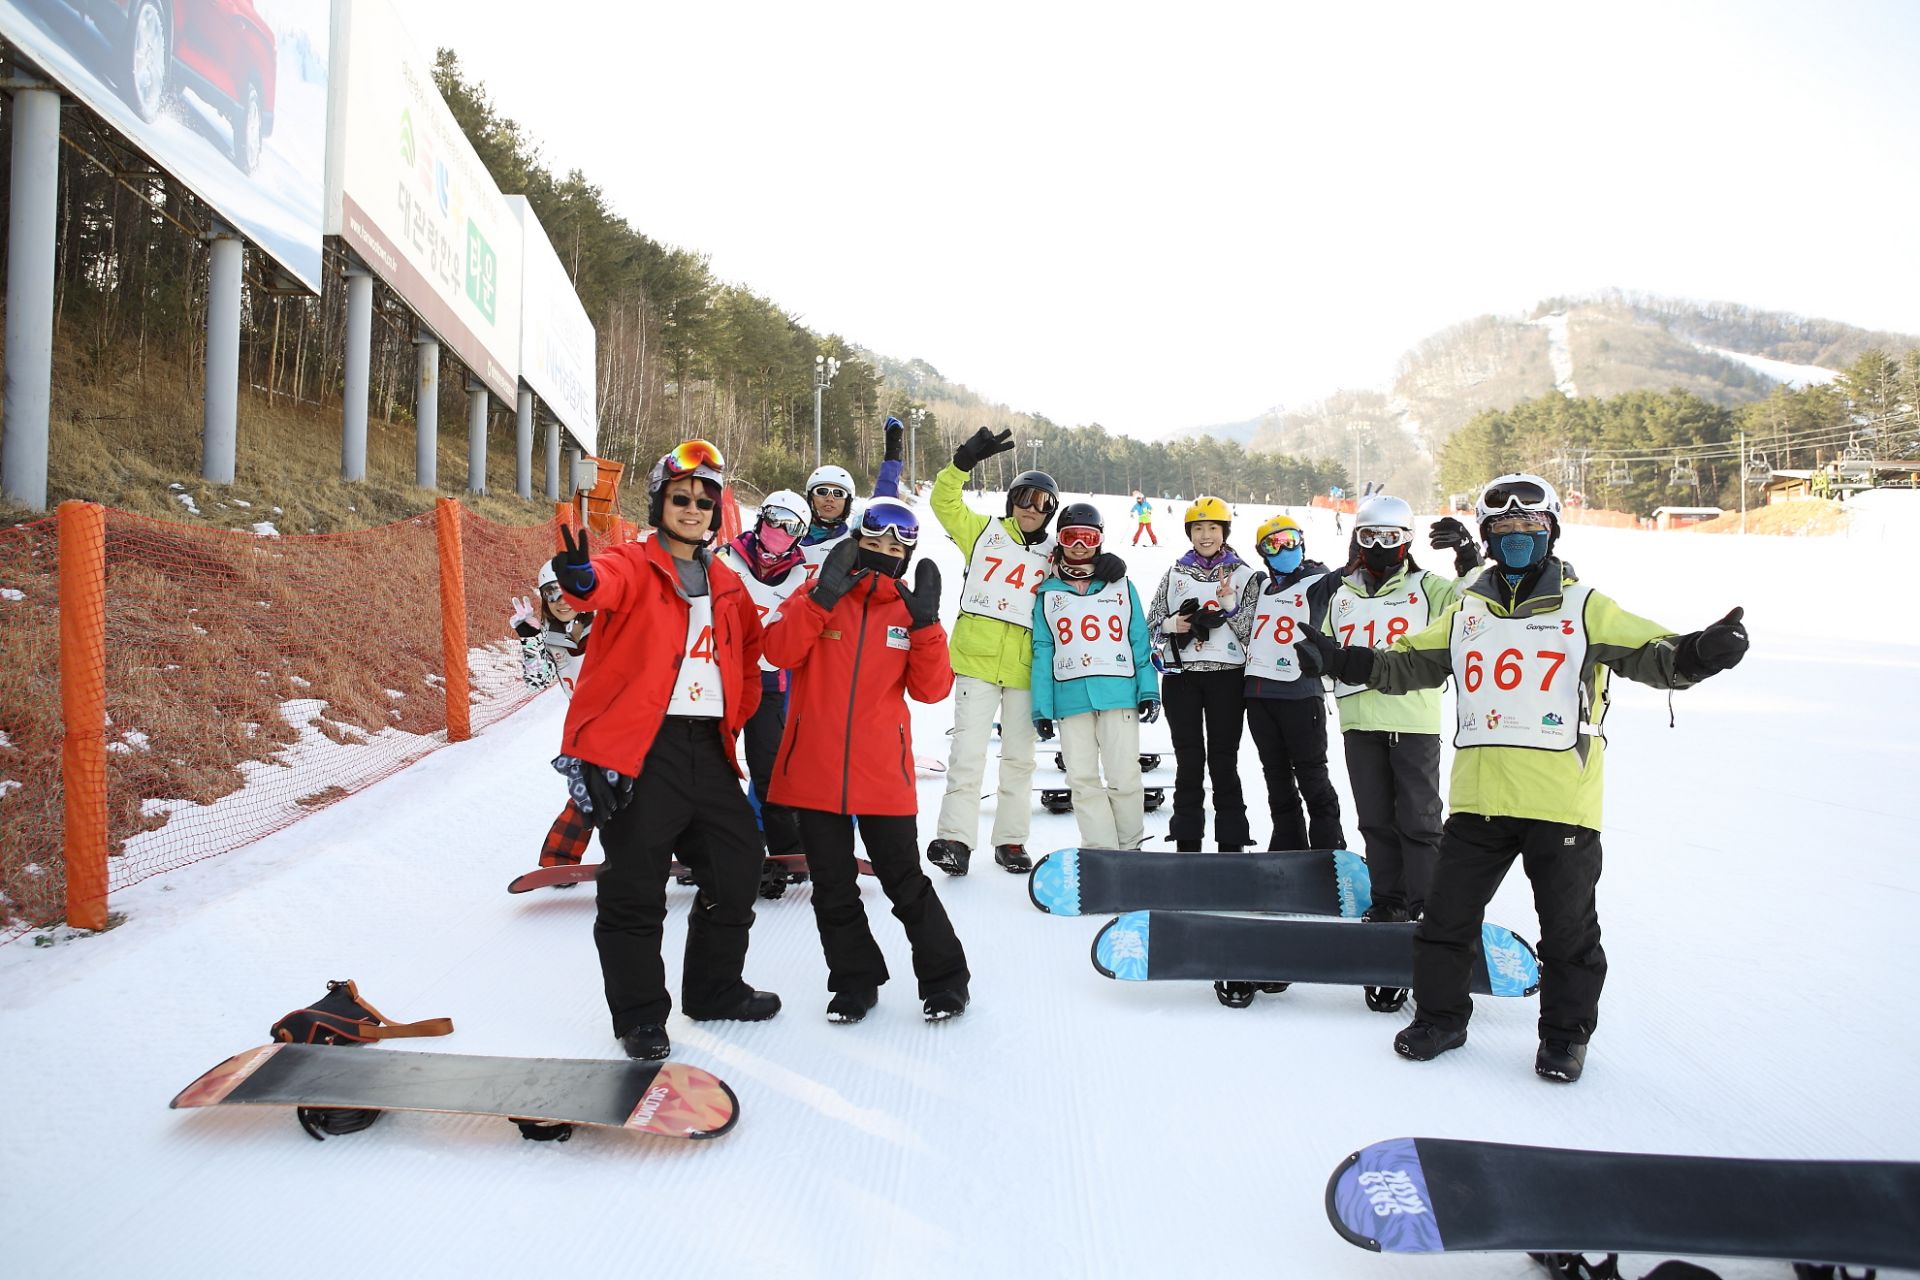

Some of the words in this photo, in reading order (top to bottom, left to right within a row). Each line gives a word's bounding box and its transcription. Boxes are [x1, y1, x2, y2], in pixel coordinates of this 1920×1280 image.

[1056, 614, 1124, 646] 869
[1338, 616, 1409, 650] 718
[1464, 647, 1566, 694] 667
[632, 1086, 669, 1126] SALOMON
